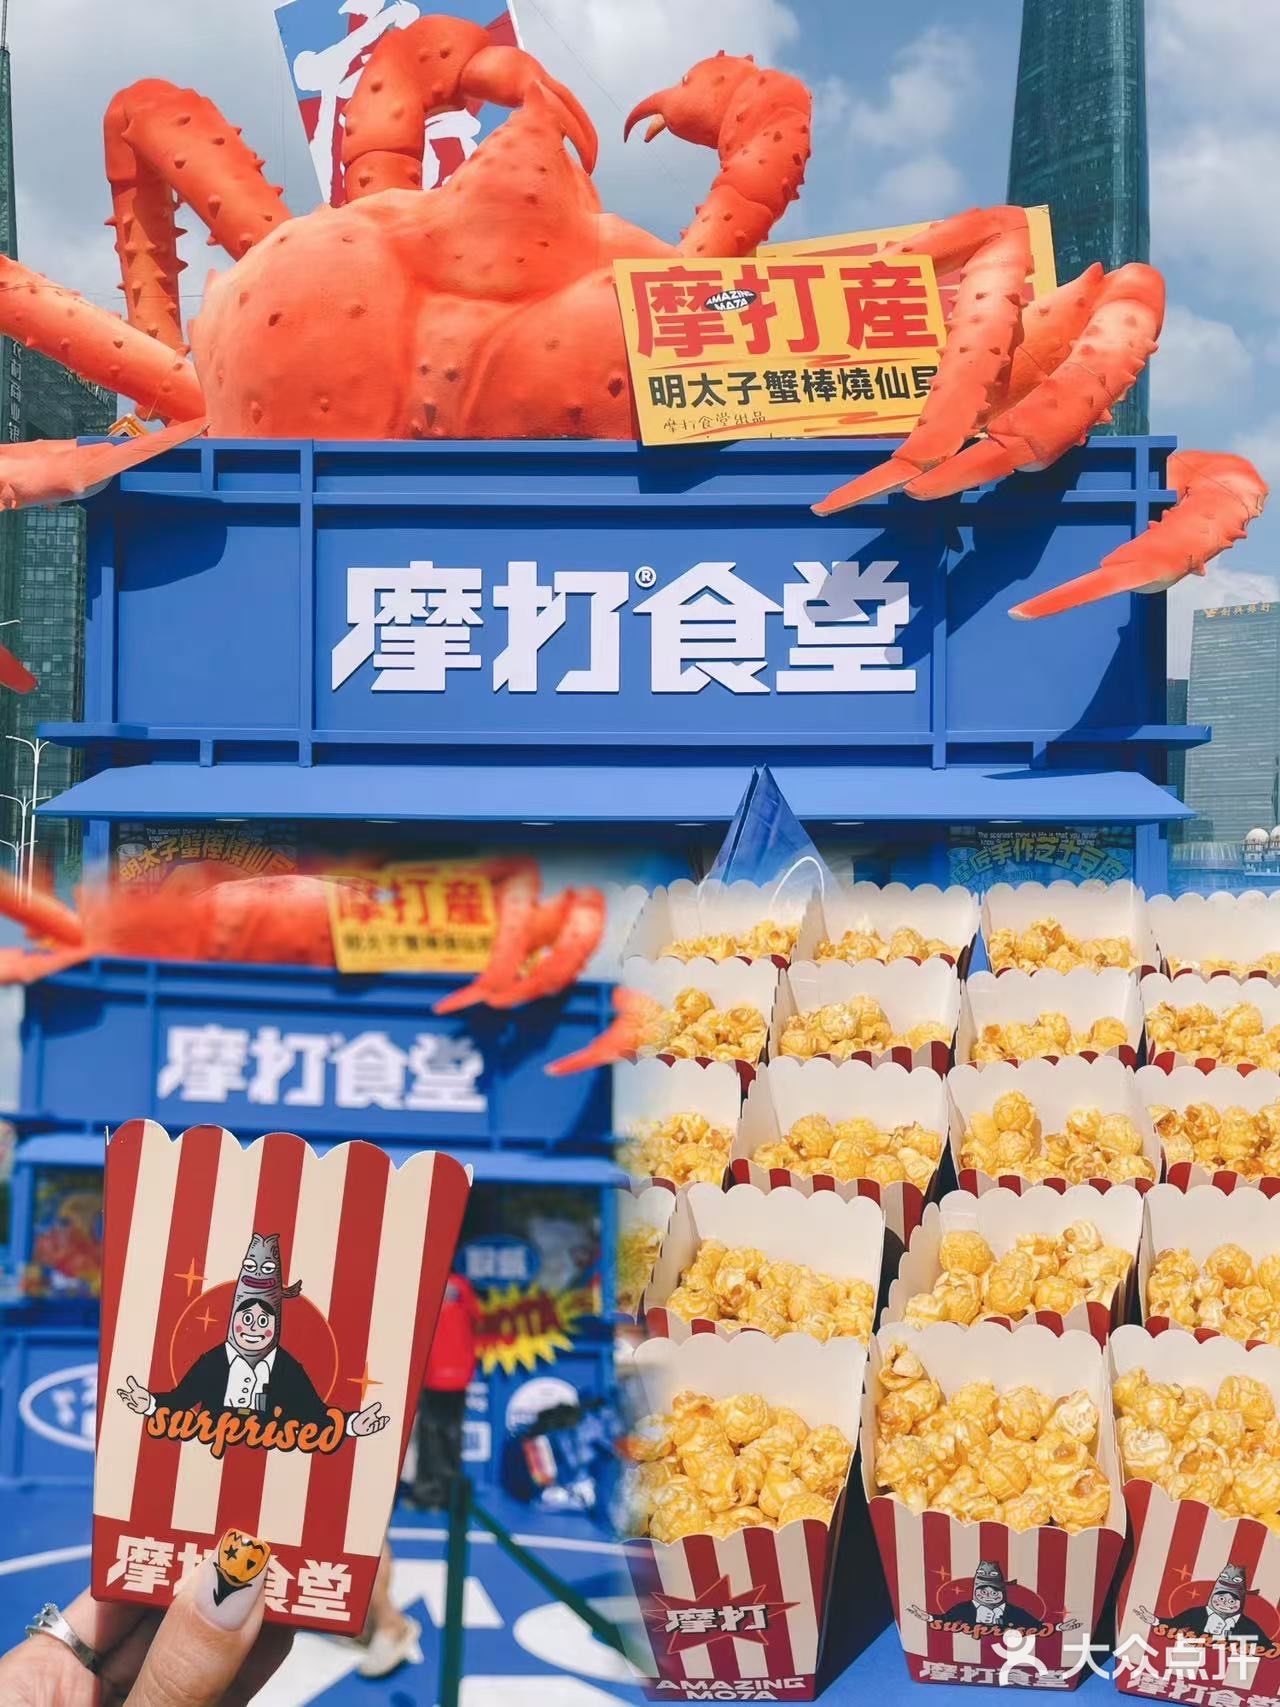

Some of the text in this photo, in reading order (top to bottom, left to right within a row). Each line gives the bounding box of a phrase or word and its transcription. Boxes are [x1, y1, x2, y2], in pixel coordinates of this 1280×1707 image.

[147, 1406, 346, 1459] surprised
[665, 1604, 768, 1633] 摩打
[656, 1678, 806, 1690] AMAZING
